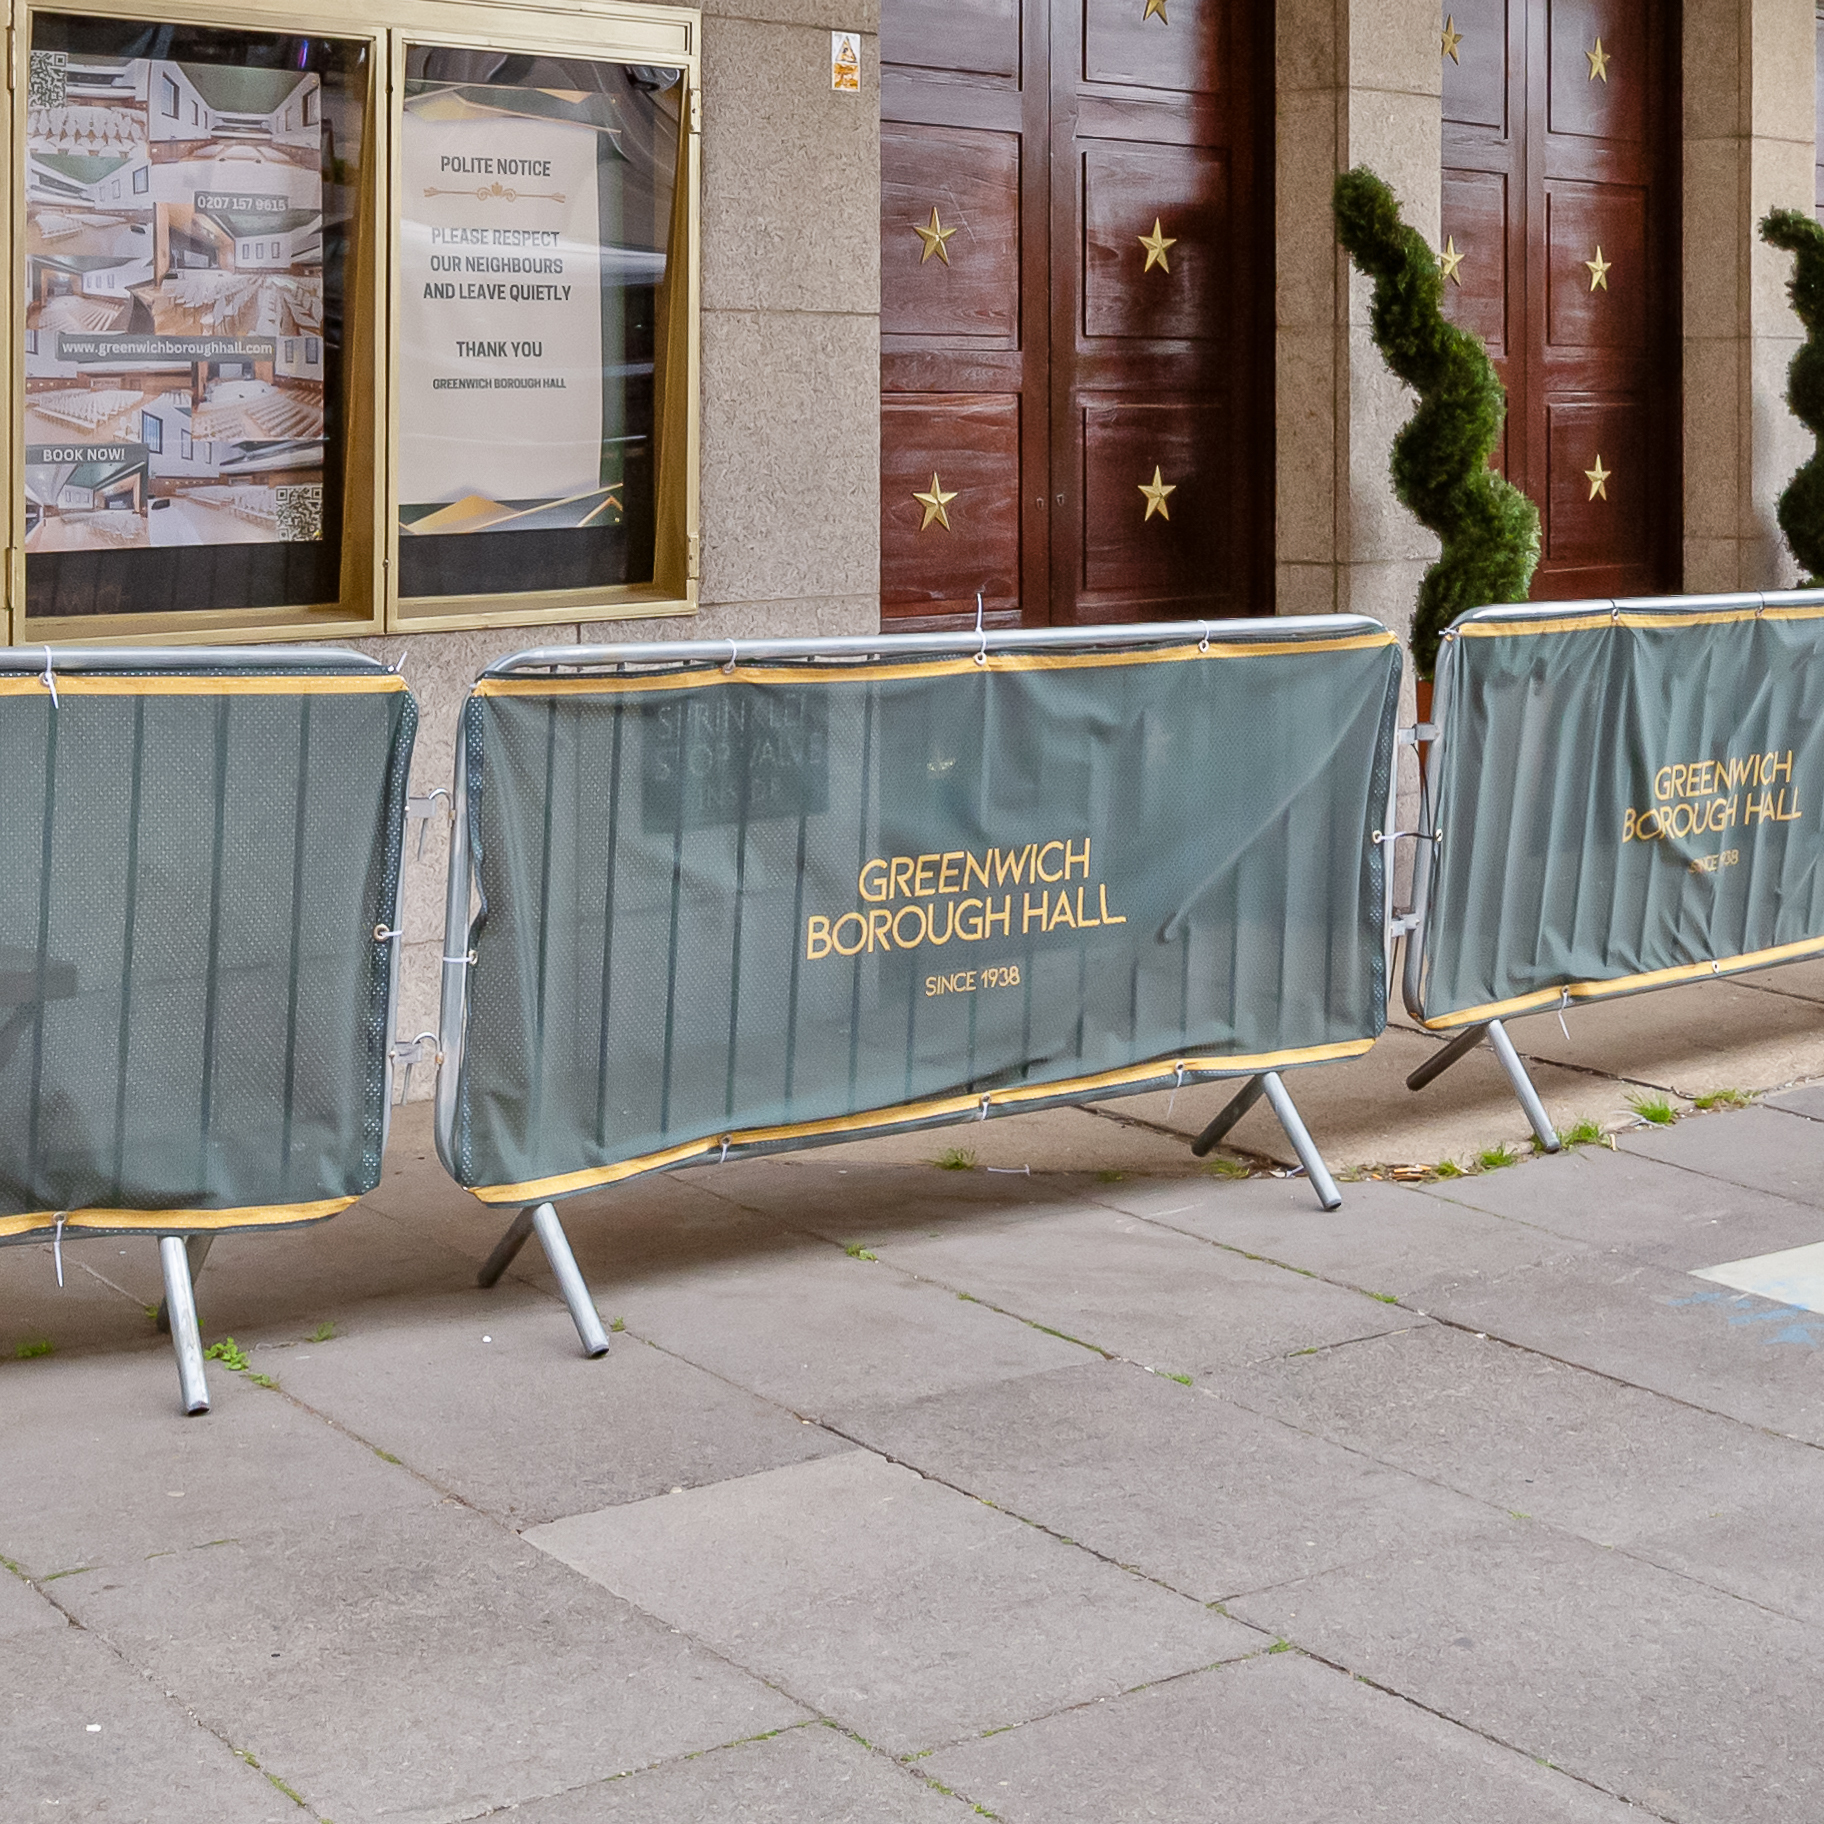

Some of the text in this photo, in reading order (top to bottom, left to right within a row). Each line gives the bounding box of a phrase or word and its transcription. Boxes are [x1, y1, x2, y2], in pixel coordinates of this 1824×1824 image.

[441, 156, 551, 177] POLITE NOTICE
[197, 195, 286, 211] 0207 157 9615
[431, 227, 560, 247] PLEASE RESPECT
[430, 255, 563, 274] OUR NEIGHBOURS
[423, 283, 571, 302] AND LEAVE QUIETLY
[62, 340, 273, 357] www.greenwichboroughhall.com
[456, 341, 543, 357] THANK YOU
[432, 378, 566, 390] GREENWICH BOROUGH HALL
[43, 447, 125, 462] BOOK NOW!
[1655, 750, 1793, 801] GREENWICH
[1622, 786, 1802, 843] BOROUGH HALL
[858, 837, 1091, 902] GREENWICH
[806, 883, 1127, 960] BOROUGH HALL
[925, 965, 1020, 996] SINCE 1938
